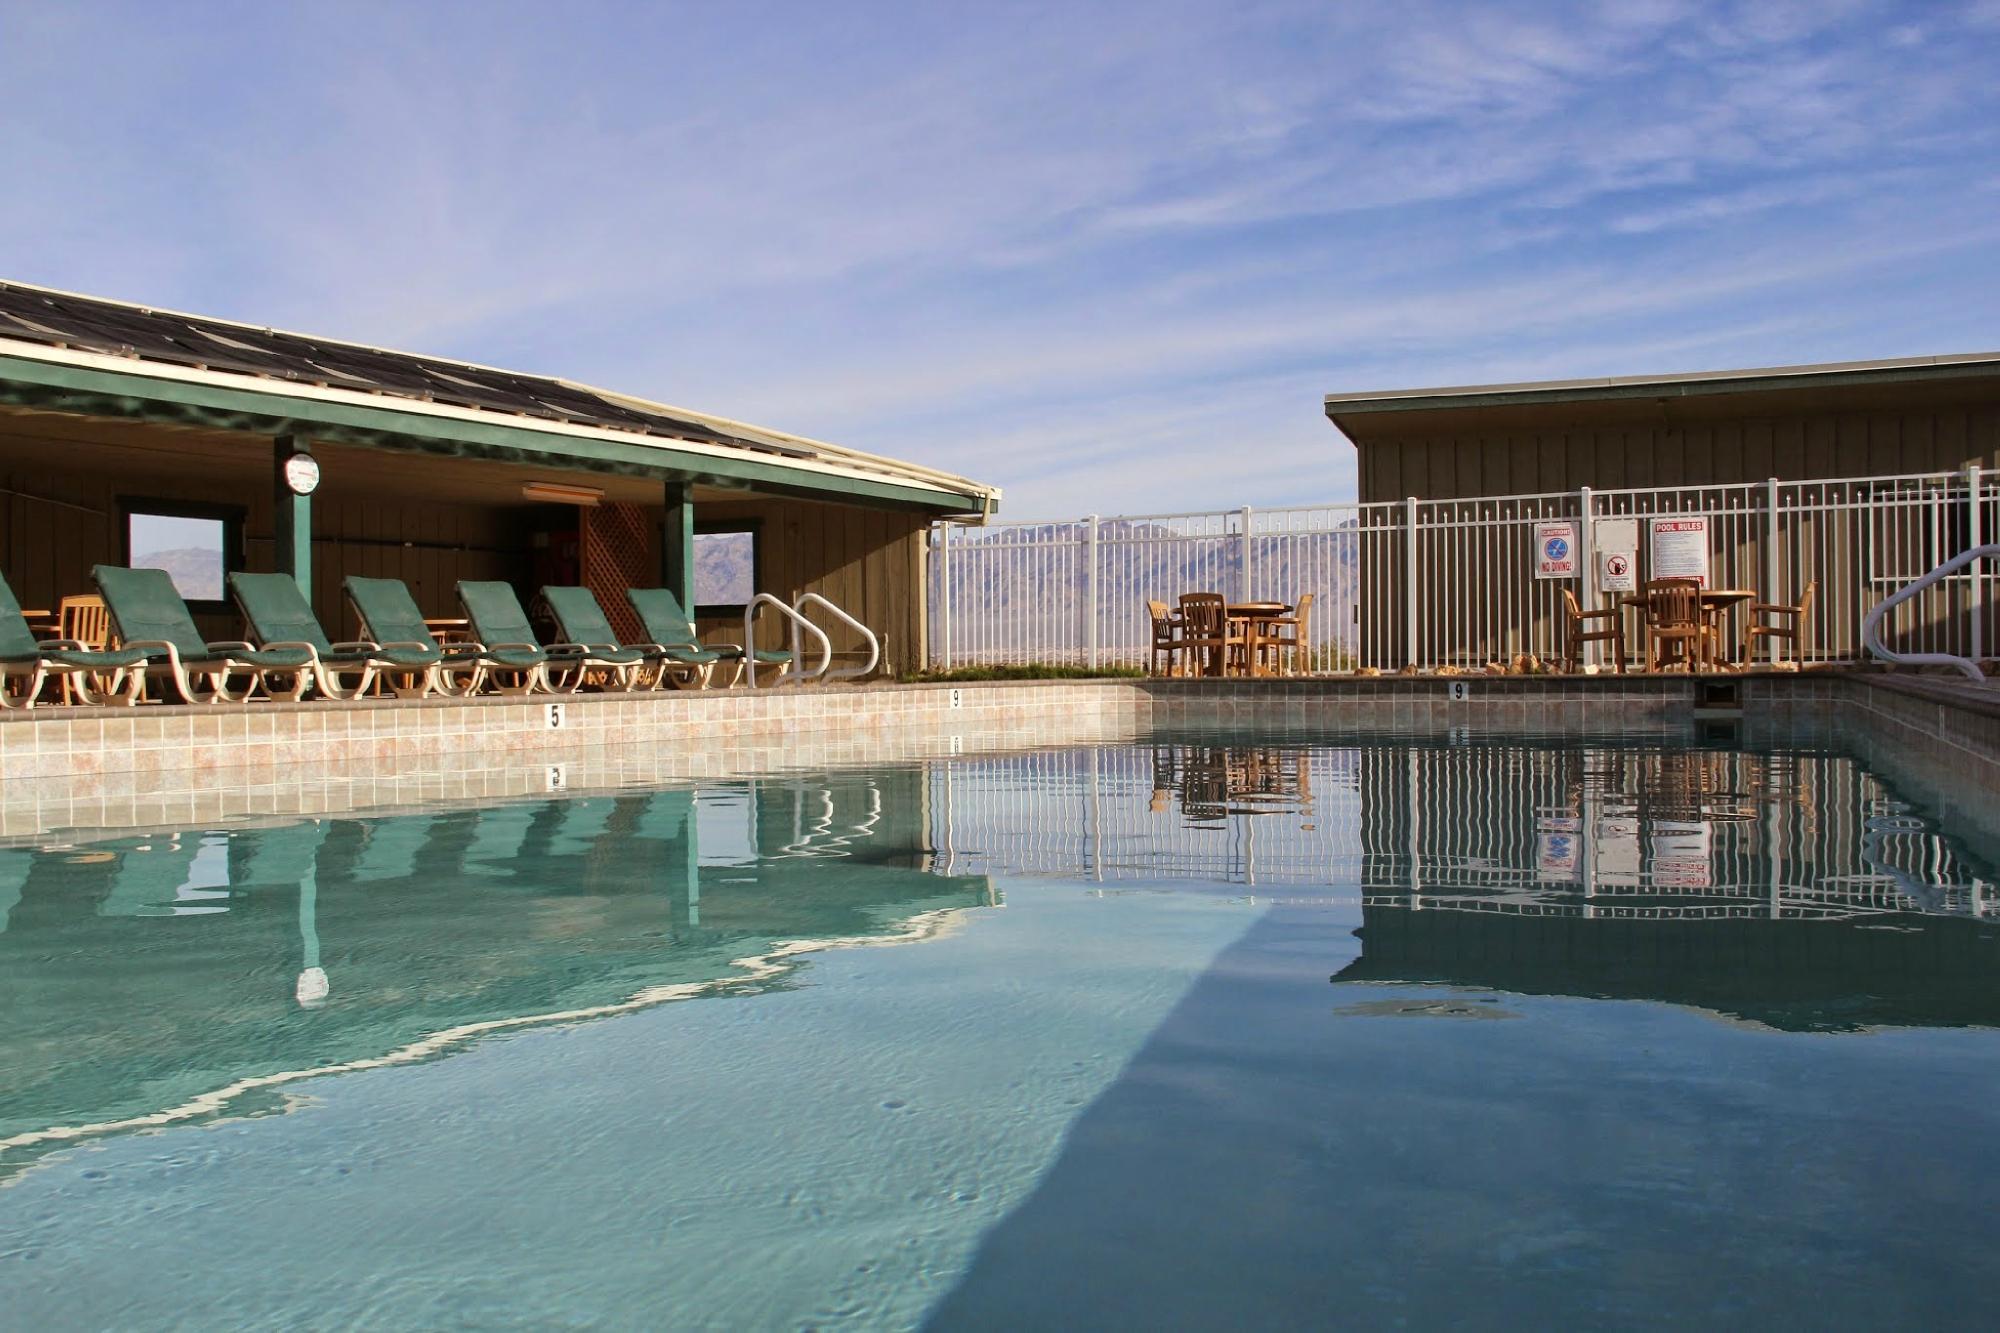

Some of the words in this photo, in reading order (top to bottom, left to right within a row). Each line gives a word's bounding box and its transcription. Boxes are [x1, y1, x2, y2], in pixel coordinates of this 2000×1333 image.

[1656, 524, 1676, 532] POOL
[1678, 522, 1702, 531] RULES
[1541, 562, 1550, 572] NO
[953, 689, 959, 707] 9
[1455, 683, 1463, 699] 9
[551, 705, 559, 727] 5
